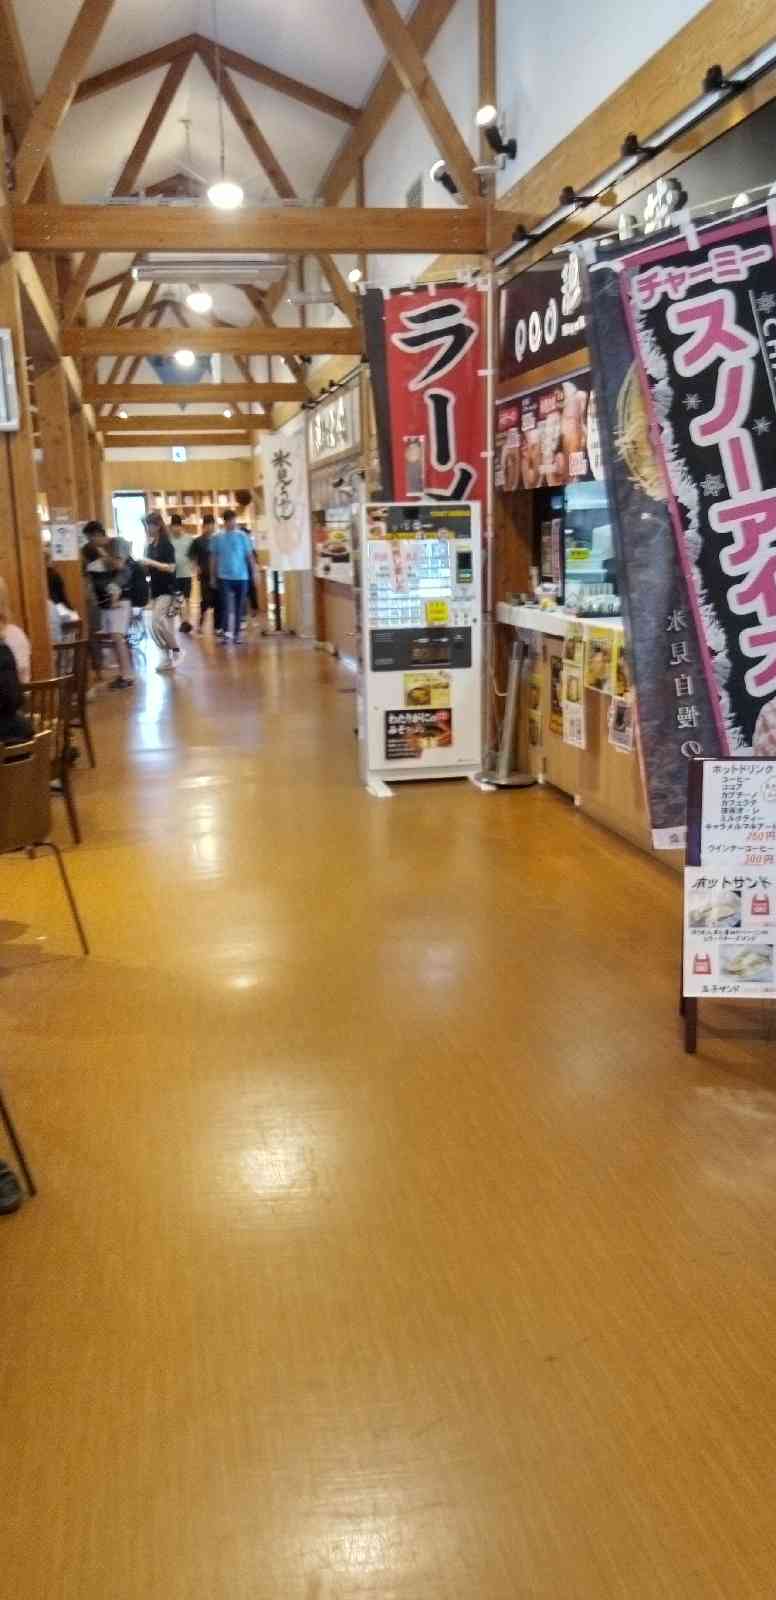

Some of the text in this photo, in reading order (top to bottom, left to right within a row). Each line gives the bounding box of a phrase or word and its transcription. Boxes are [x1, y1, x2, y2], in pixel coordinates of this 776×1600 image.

[632, 244, 773, 310] チャーミー
[712, 765, 774, 776] ホットドリンク
[691, 876, 772, 890] ホットサンド
